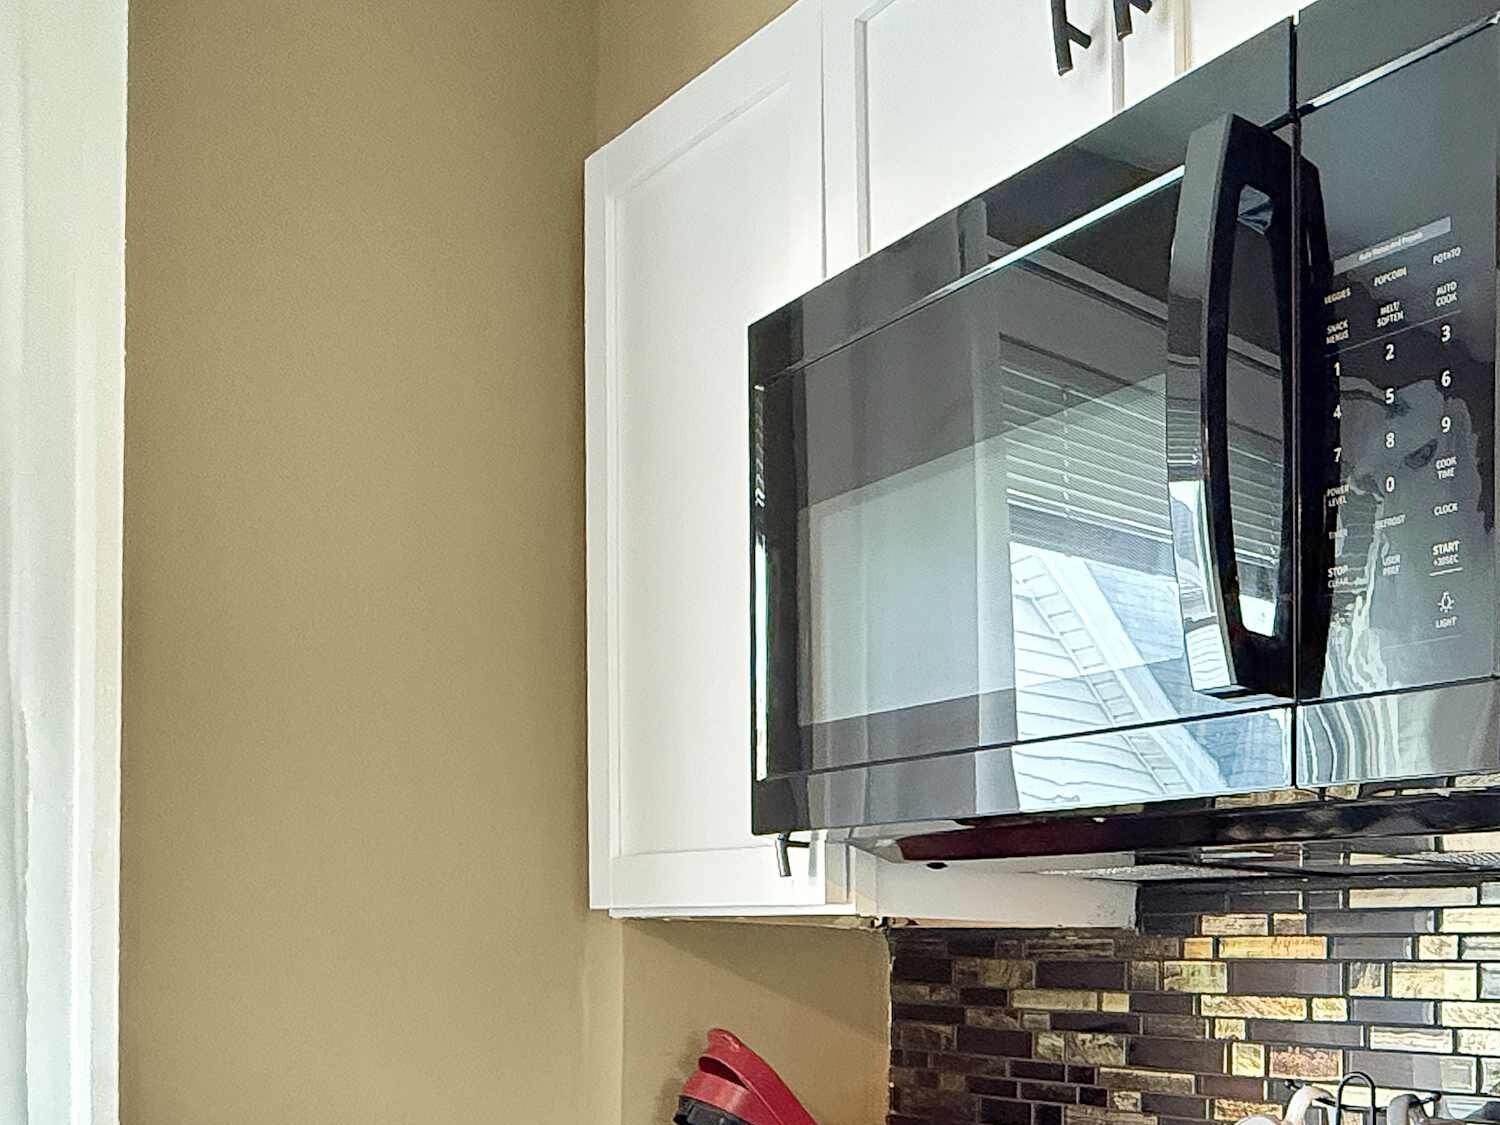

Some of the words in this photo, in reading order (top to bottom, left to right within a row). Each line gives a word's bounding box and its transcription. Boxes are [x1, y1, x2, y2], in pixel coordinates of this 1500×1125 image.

[1433, 247, 1461, 264] POTATO
[1374, 266, 1407, 287] POPCORN
[1436, 281, 1457, 296] AUTO
[1435, 292, 1457, 307] COOK
[1377, 311, 1404, 327] SOFTEN
[1327, 320, 1348, 334] SNACK
[1441, 325, 1451, 342] 3
[1385, 344, 1395, 360] 2
[1334, 362, 1341, 376] 1
[1441, 370, 1451, 387] 6
[1385, 388, 1395, 404] 5
[1333, 405, 1342, 420] 4
[1441, 416, 1451, 432] 9
[1385, 432, 1395, 448] 8
[1333, 448, 1342, 463] 7
[1436, 456, 1457, 469] COOK
[1437, 467, 1455, 479] TIME
[1327, 484, 1349, 497] POWER
[1385, 476, 1395, 492] 0
[1328, 494, 1347, 507] LEVEL
[1434, 503, 1458, 516] CLOCK
[1432, 540, 1460, 556] START
[1328, 565, 1348, 578] STOP
[1435, 617, 1457, 629] LIGHT
